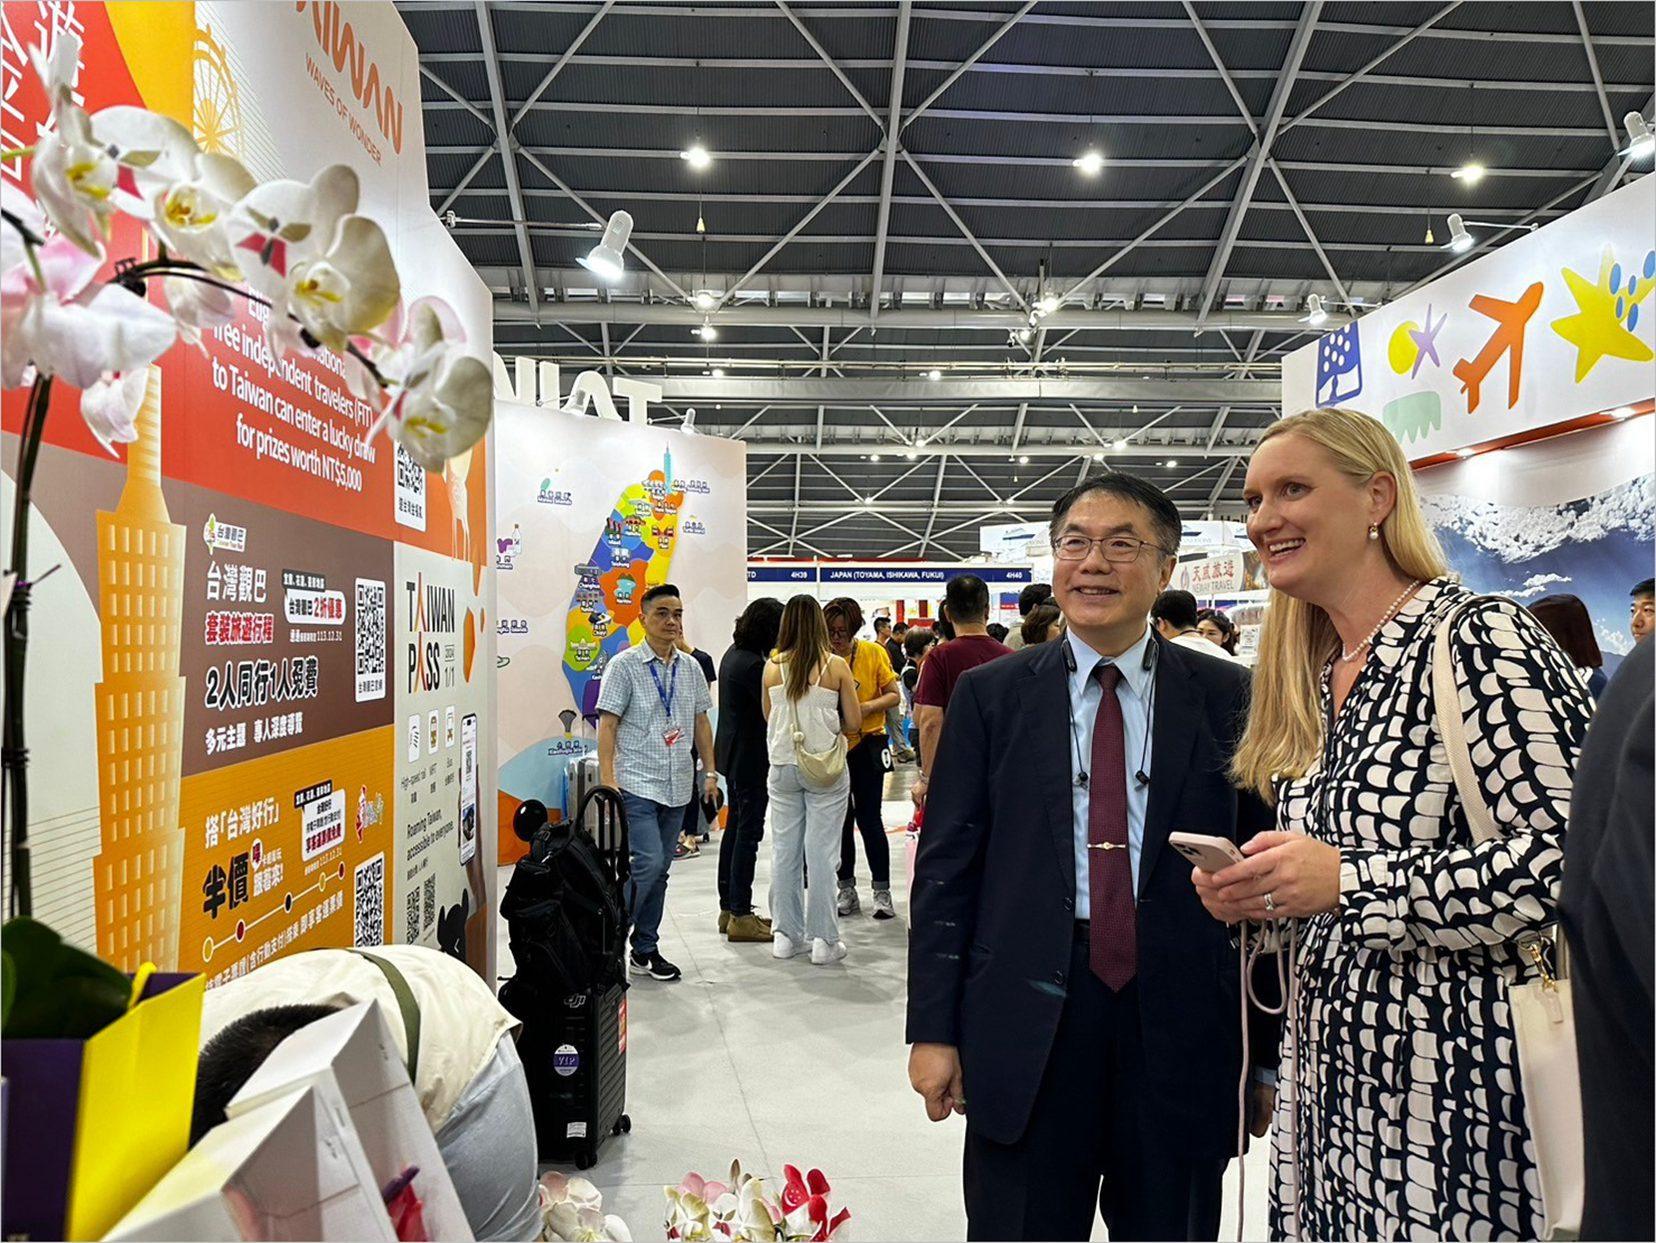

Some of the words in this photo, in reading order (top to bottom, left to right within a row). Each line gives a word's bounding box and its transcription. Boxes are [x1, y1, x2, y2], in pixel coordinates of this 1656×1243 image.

[306, 52, 335, 107] WAVES
[336, 98, 349, 121] OF
[349, 113, 381, 167] WONDER
[212, 356, 228, 391] to
[229, 364, 273, 415] Taiwan
[274, 396, 295, 425] can
[294, 408, 321, 440] enter
[322, 421, 329, 437] a
[329, 418, 354, 459] lucky
[314, 377, 354, 421] travelers
[236, 413, 256, 447] for
[256, 428, 290, 465] prizes
[290, 445, 321, 478] worth
[321, 455, 362, 493] NT$5,000
[207, 560, 267, 604] 台灣觀巴
[830, 571, 853, 579] JAPAN
[853, 571, 886, 580] (TOYAMA,
[886, 571, 920, 580] ISHIKAWA,
[921, 571, 945, 580] FUKUI)
[1212, 579, 1234, 591] TRAVEL
[406, 571, 455, 633] TAIWAN
[205, 611, 275, 646] 套裝旅遊行程
[204, 654, 319, 711] 2人同行1人免費
[408, 631, 440, 694] PASS
[204, 722, 247, 756] 多元主題
[254, 711, 304, 744] 專人深度導覽
[205, 797, 280, 849] 搭「台灣好行」
[406, 817, 427, 839] Roaming
[202, 850, 250, 920] 半價
[558, 1055, 575, 1066] VIP
